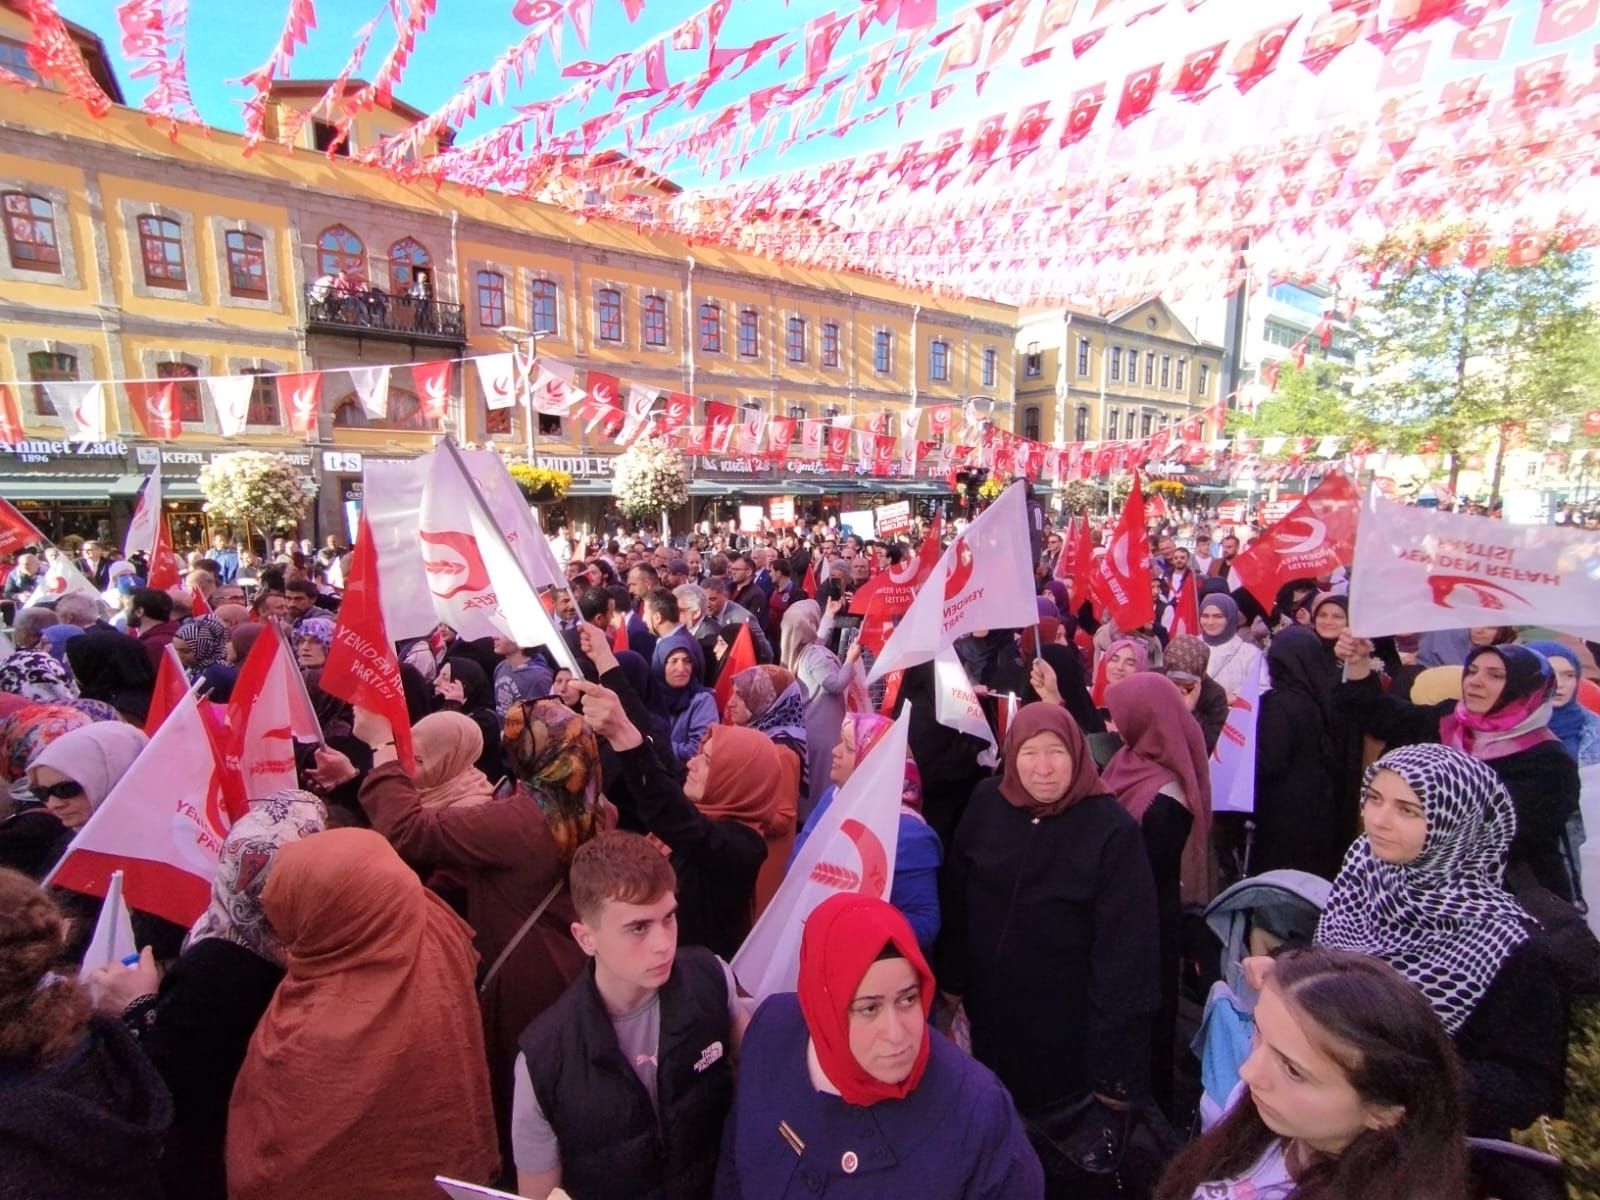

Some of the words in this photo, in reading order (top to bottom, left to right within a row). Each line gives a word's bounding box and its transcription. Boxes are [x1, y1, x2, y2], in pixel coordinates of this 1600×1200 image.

[21, 454, 49, 463] 1896
[162, 452, 209, 464] KRAL
[537, 457, 609, 474] MIDDLE
